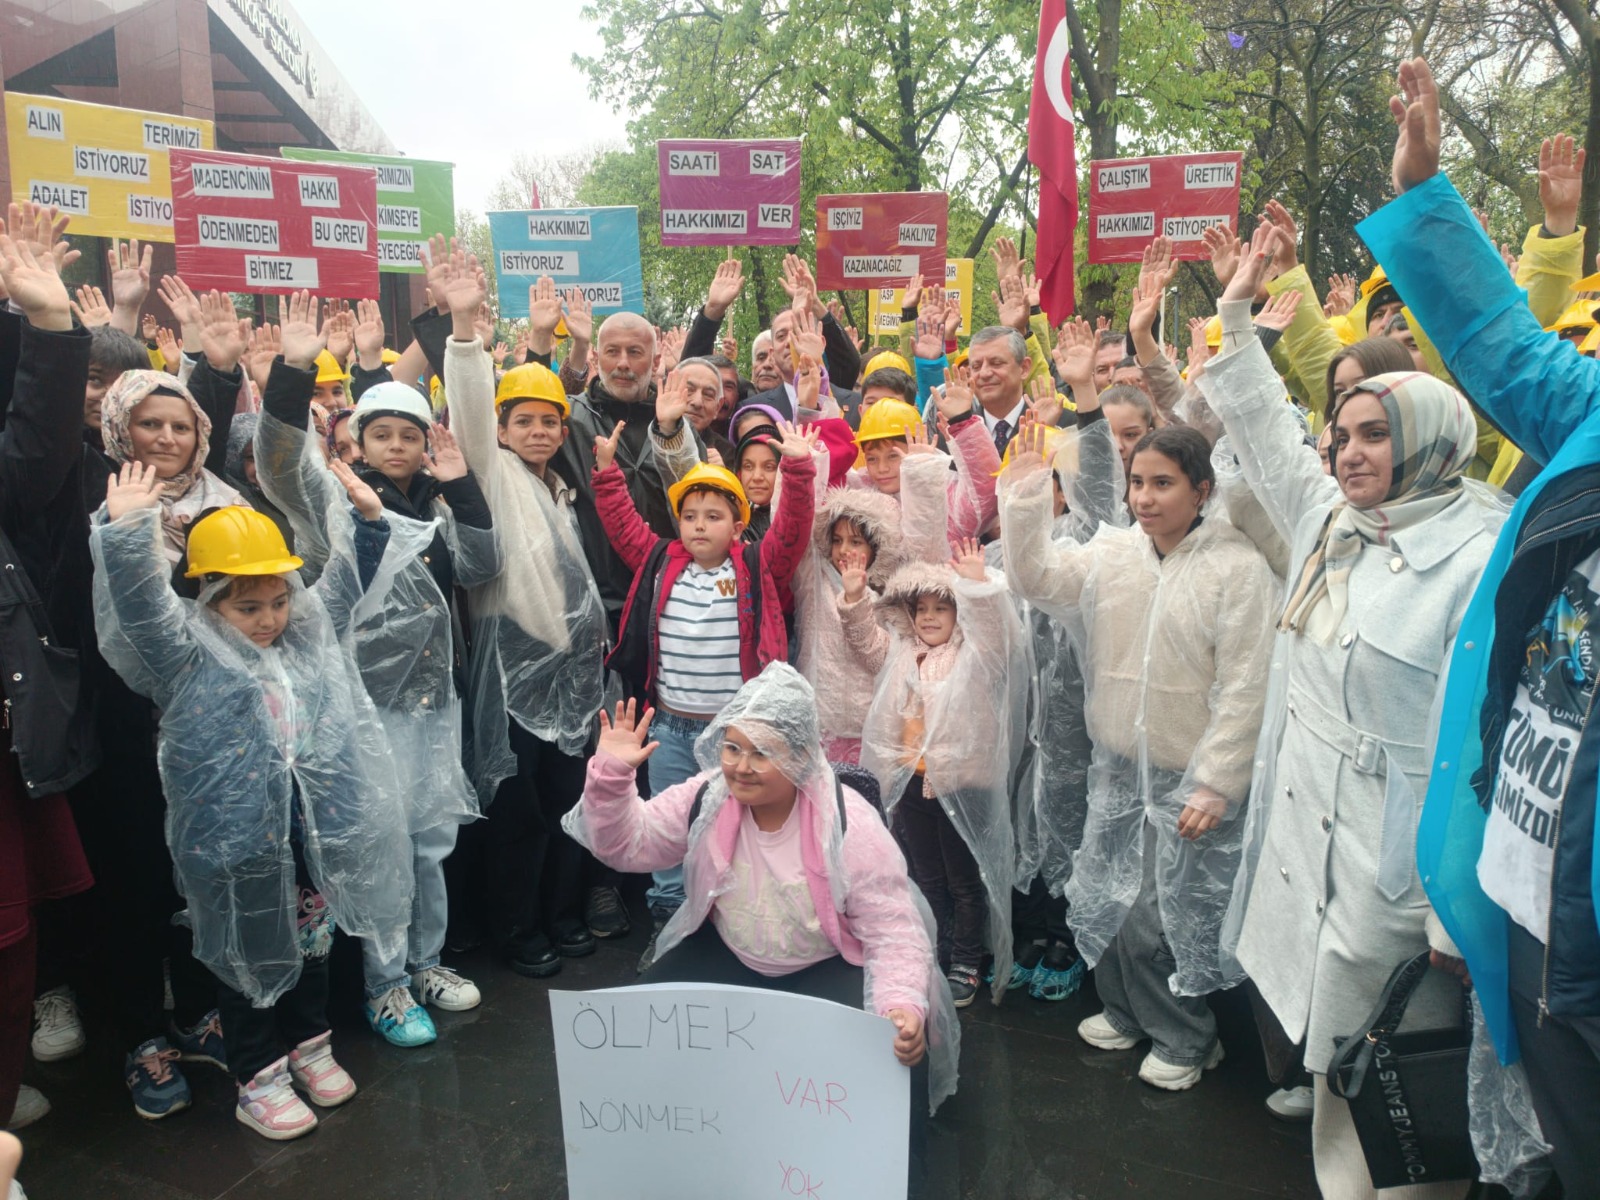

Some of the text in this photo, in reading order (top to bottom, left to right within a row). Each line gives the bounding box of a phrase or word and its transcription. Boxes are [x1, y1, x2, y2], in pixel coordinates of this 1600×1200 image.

[28, 109, 200, 149] ALIN TERİMİZİ
[75, 145, 148, 177] İSTİYORUZ
[670, 152, 783, 171] SAATİ SAT
[193, 166, 338, 201] MADENCİNİN HAKKI
[1099, 163, 1234, 190] ÇALIŞTIK ÜRETTİK
[31, 184, 88, 210] ADALET
[378, 204, 418, 227] KİMSEYE
[666, 207, 792, 228] HAKKIMIZI VER
[833, 209, 861, 229] İŞÇİYİZ
[1099, 216, 1153, 233] HAKKIMIZI
[201, 215, 365, 245] ÖDENMEDEN BU GREV
[530, 220, 590, 236] HAKKIMIZI
[900, 227, 936, 242] HAKLIYIZ
[250, 256, 294, 280] BİTMEZ
[502, 252, 564, 270] İSTİYORUZ
[844, 256, 902, 273] KAZANACAĞIZ
[715, 578, 737, 597] W
[572, 1001, 756, 1051] ÖLMEK
[775, 1071, 853, 1123] VAR
[579, 1097, 722, 1135] DÖNMEK
[777, 1159, 824, 1200] YOK
